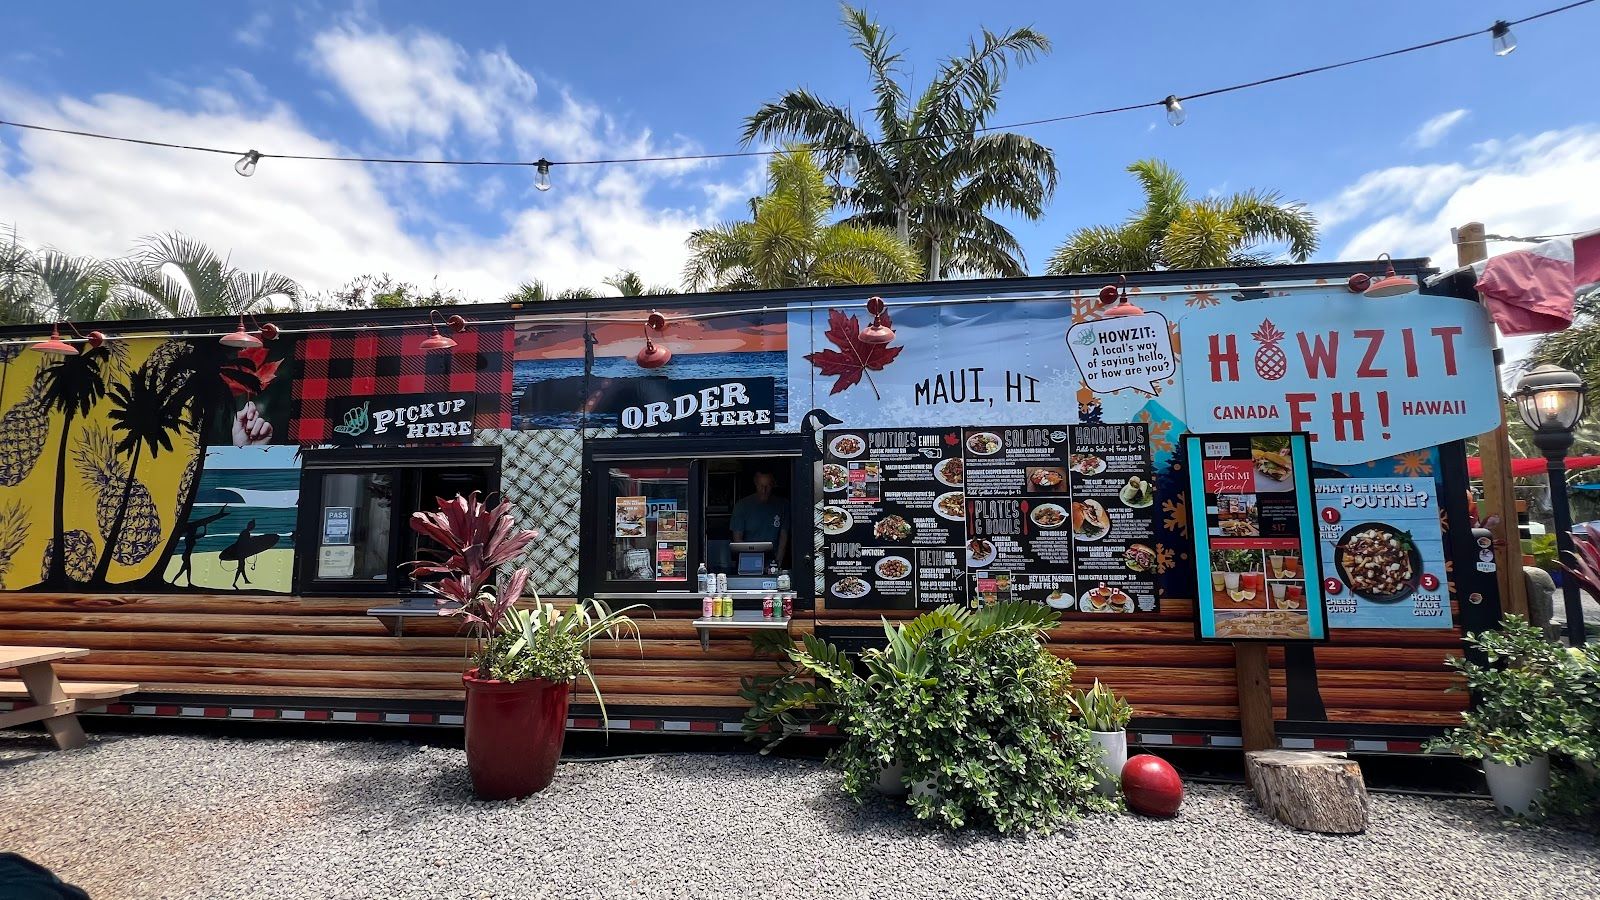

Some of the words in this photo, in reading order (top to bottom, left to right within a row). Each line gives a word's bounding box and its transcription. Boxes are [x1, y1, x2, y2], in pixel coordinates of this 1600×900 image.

[1098, 326, 1156, 344] HOWZIT:
[1092, 347, 1100, 357] A
[1101, 343, 1134, 355] local's
[1136, 342, 1158, 352] way
[1087, 357, 1097, 369] of
[1101, 355, 1135, 368] saying
[1137, 350, 1167, 363] hello,
[1088, 370, 1099, 380] or
[1101, 368, 1122, 378] how
[1125, 367, 1142, 376] are
[1145, 361, 1170, 376] you?
[914, 367, 994, 408] MAUI,
[1005, 370, 1041, 404] HI
[621, 382, 750, 430] ORDER
[700, 409, 771, 427] HERE
[1213, 404, 1280, 420] CANADA
[1285, 391, 1392, 442] EH!
[1402, 400, 1467, 416] HAWAII
[406, 420, 473, 439] HERE
[1075, 425, 1145, 445] HANDHELDS
[868, 431, 917, 448] POUTINES
[1004, 429, 1050, 448] SALADS
[1207, 472, 1235, 481] BAHN
[1237, 472, 1250, 480] MI
[1213, 480, 1248, 495] Special
[1314, 484, 1344, 493] WHAT
[1347, 484, 1369, 493] THE
[1371, 483, 1399, 492] HECK
[1402, 483, 1413, 492] IS
[1341, 491, 1429, 509] POUTINE?
[328, 511, 348, 519] PASS
[974, 500, 1020, 519] PLATES
[1326, 510, 1333, 520] 1
[985, 518, 1021, 535] BOWLS
[830, 542, 862, 559] PUPUS
[1028, 575, 1039, 583] KEY
[1039, 575, 1051, 583] LIME
[1051, 575, 1074, 583] PASSION
[1043, 582, 1052, 590] PIE
[1328, 581, 1336, 590] 2
[1424, 576, 1433, 586] 3
[1326, 598, 1358, 606] CHEESE
[1327, 605, 1357, 613] CURDS
[1414, 601, 1440, 609] MADE
[1412, 609, 1443, 617] GRAVY
